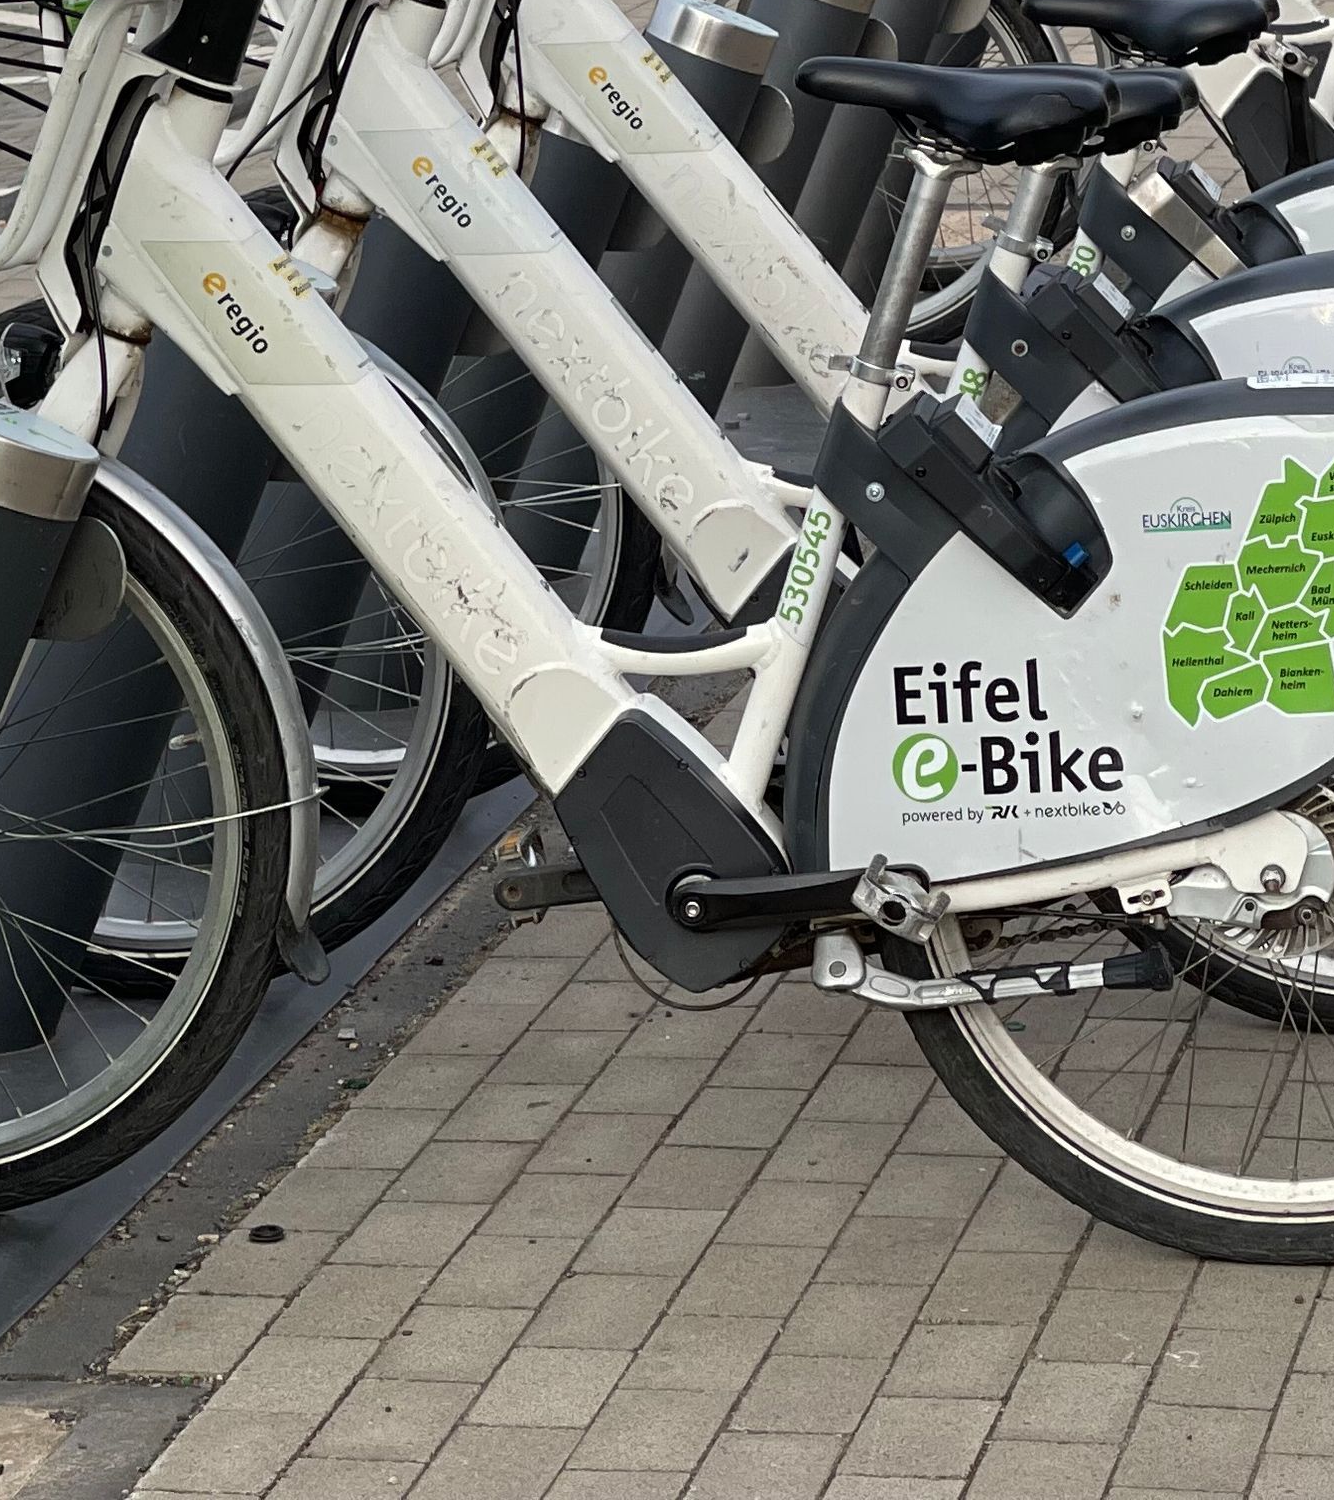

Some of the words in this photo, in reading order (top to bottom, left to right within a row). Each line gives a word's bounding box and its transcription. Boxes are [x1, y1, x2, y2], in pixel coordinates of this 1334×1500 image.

[1143, 511, 1231, 528] EUSKIRCHEN
[1260, 514, 1295, 525] Zülpich
[779, 508, 831, 624] 530545
[1246, 564, 1305, 574] Mechernich
[1185, 581, 1232, 590] Schleiden
[1311, 585, 1330, 594] Bad
[1236, 612, 1254, 621] Kall
[1272, 620, 1313, 629] Netters-
[1272, 632, 1297, 640] heim
[1172, 657, 1224, 667] Hellenthal
[1280, 668, 1324, 678] Blanken-
[1280, 680, 1305, 690] heim
[893, 658, 1048, 725] Eifel
[1214, 688, 1253, 697] Dahlem
[892, 730, 1124, 803] e-Bike
[902, 808, 963, 825] powered
[967, 808, 984, 823] by
[1035, 802, 1101, 818] nextbike
